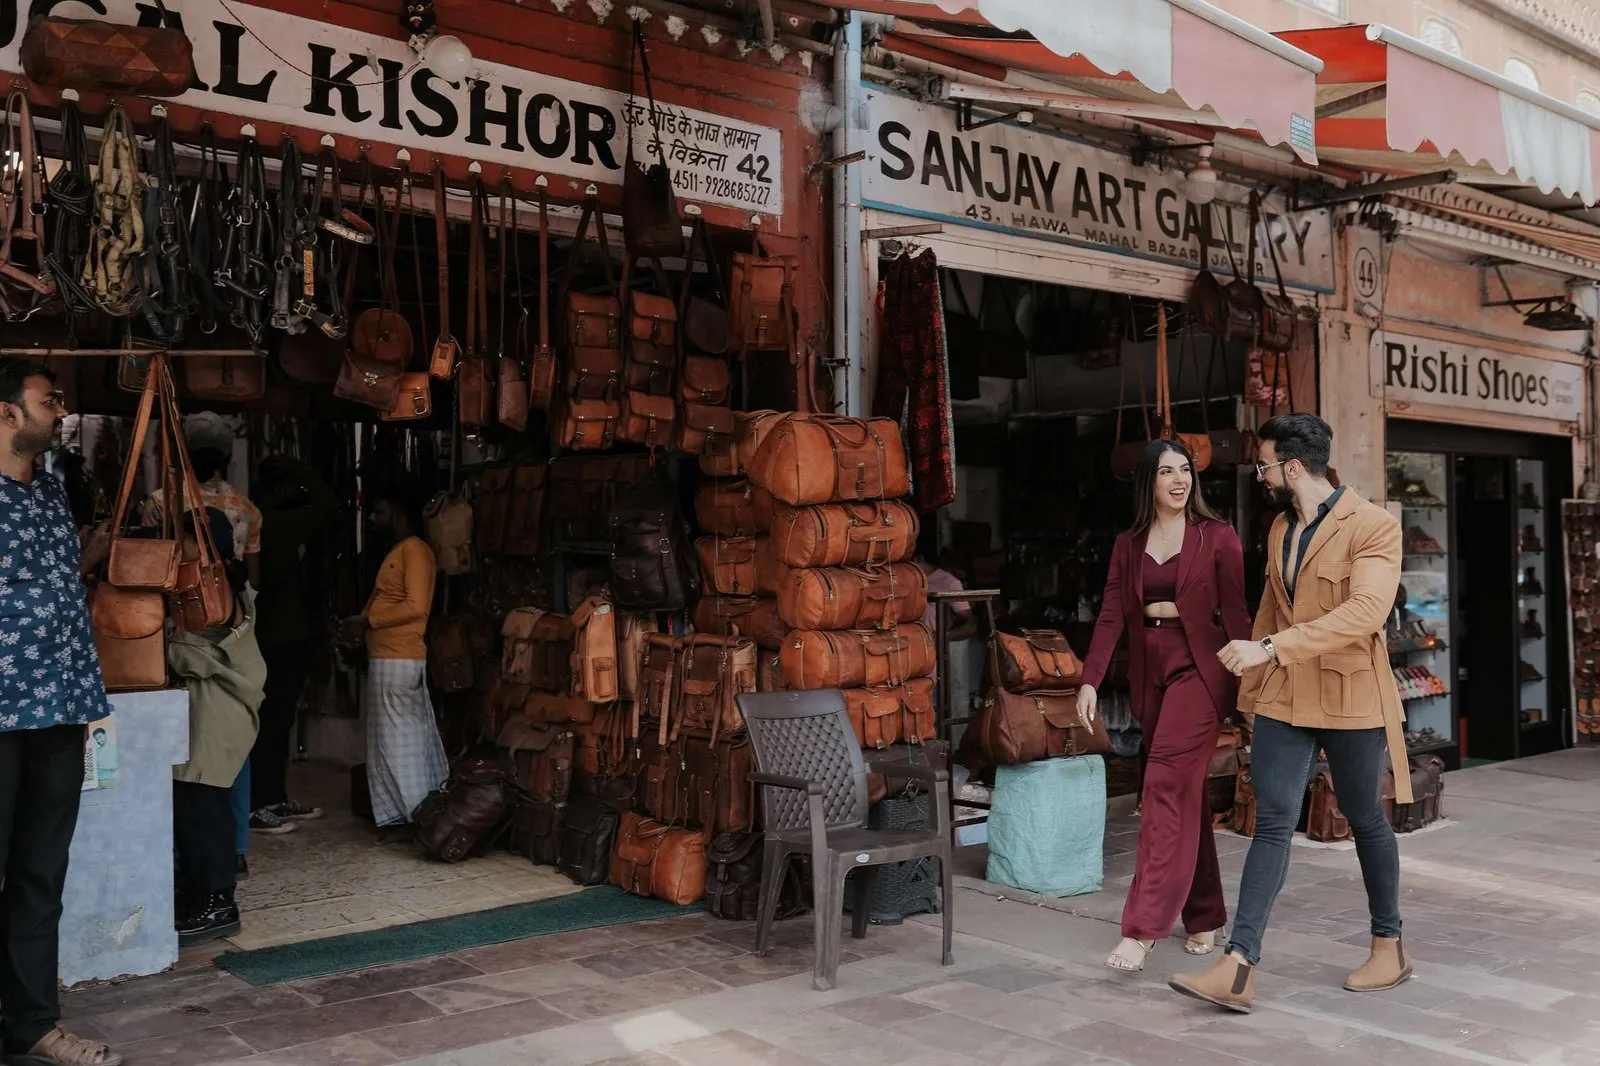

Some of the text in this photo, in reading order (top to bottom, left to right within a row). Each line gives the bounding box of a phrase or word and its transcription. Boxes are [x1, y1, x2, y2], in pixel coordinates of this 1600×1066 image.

[304, 42, 621, 170] KISHOR
[669, 139, 728, 172] विक्रेता
[694, 119, 721, 143] साज
[723, 126, 761, 151] सामान
[736, 153, 772, 184] 42
[878, 121, 1060, 214] SANJAY
[1071, 166, 1146, 232] ART
[1011, 212, 1071, 236] HAWA
[1084, 228, 1139, 250] MAHAL
[1148, 240, 1198, 263] BAZAR
[1358, 260, 1373, 290] 44
[1384, 341, 1469, 397] Rishi
[1477, 357, 1549, 406] Shoes
